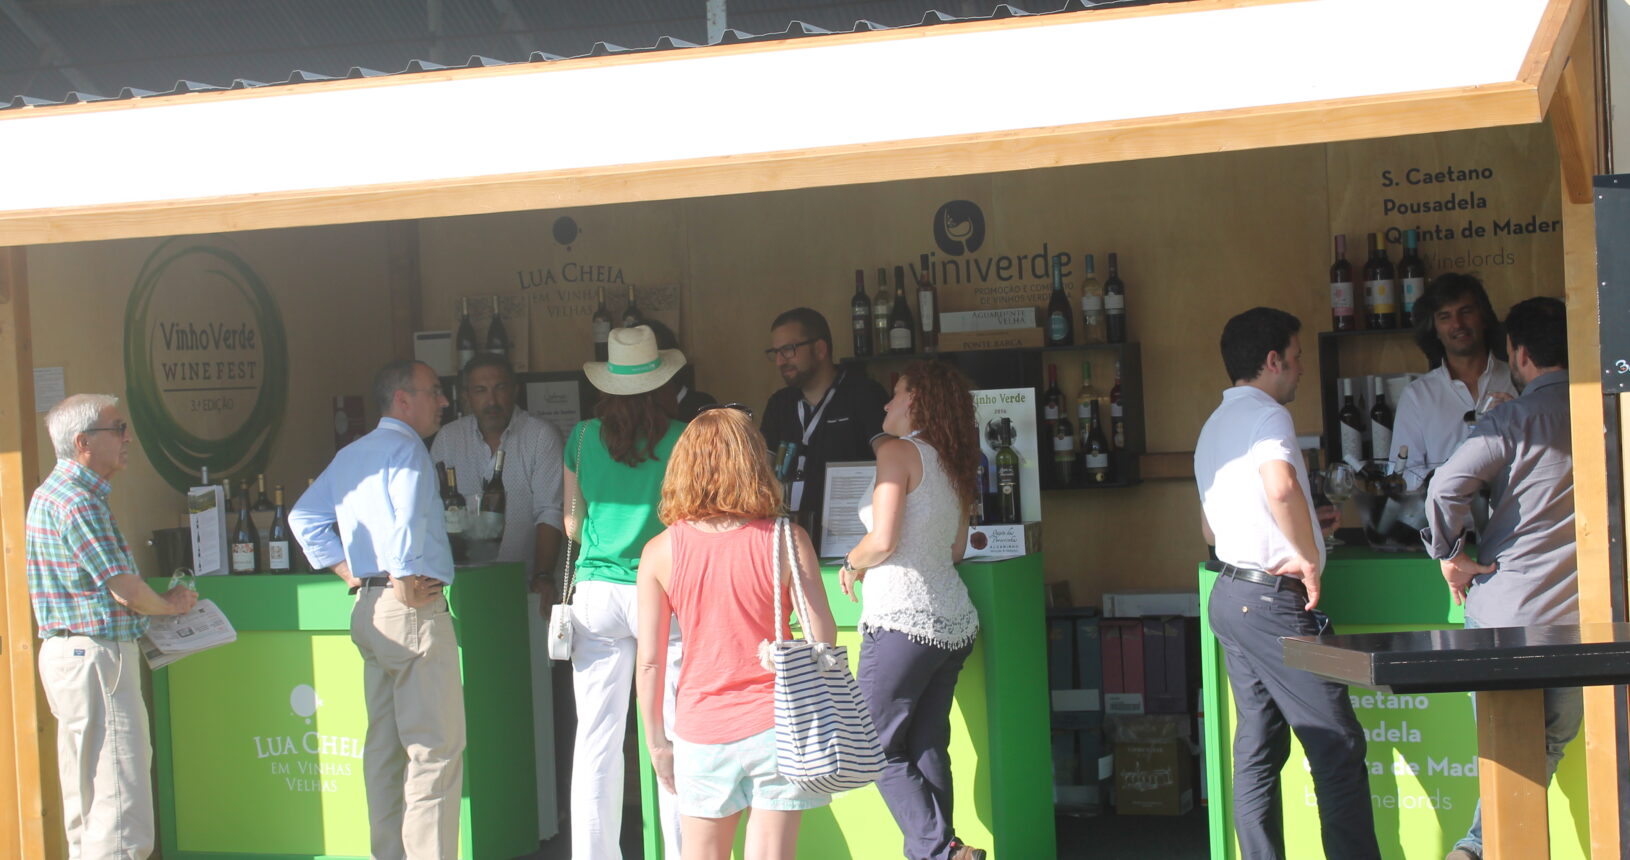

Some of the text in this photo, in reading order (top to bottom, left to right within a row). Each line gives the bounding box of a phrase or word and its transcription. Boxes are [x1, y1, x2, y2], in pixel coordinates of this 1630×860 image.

[1381, 166, 1493, 187] S. Caetano
[1384, 191, 1487, 215] Pousadela
[1386, 216, 1561, 244] Qinta de Mader
[517, 262, 626, 289] LUA CHEIA
[162, 361, 256, 381] WINE FEST
[1000, 393, 1026, 404] Verde
[1350, 691, 1429, 709] aetano
[253, 731, 364, 759] LUA CHEI
[271, 761, 352, 776] EM VINHAS
[1391, 754, 1420, 776] de
[1428, 756, 1479, 777] Mad
[286, 777, 337, 792] VELHAS
[1371, 788, 1453, 810] nelords
